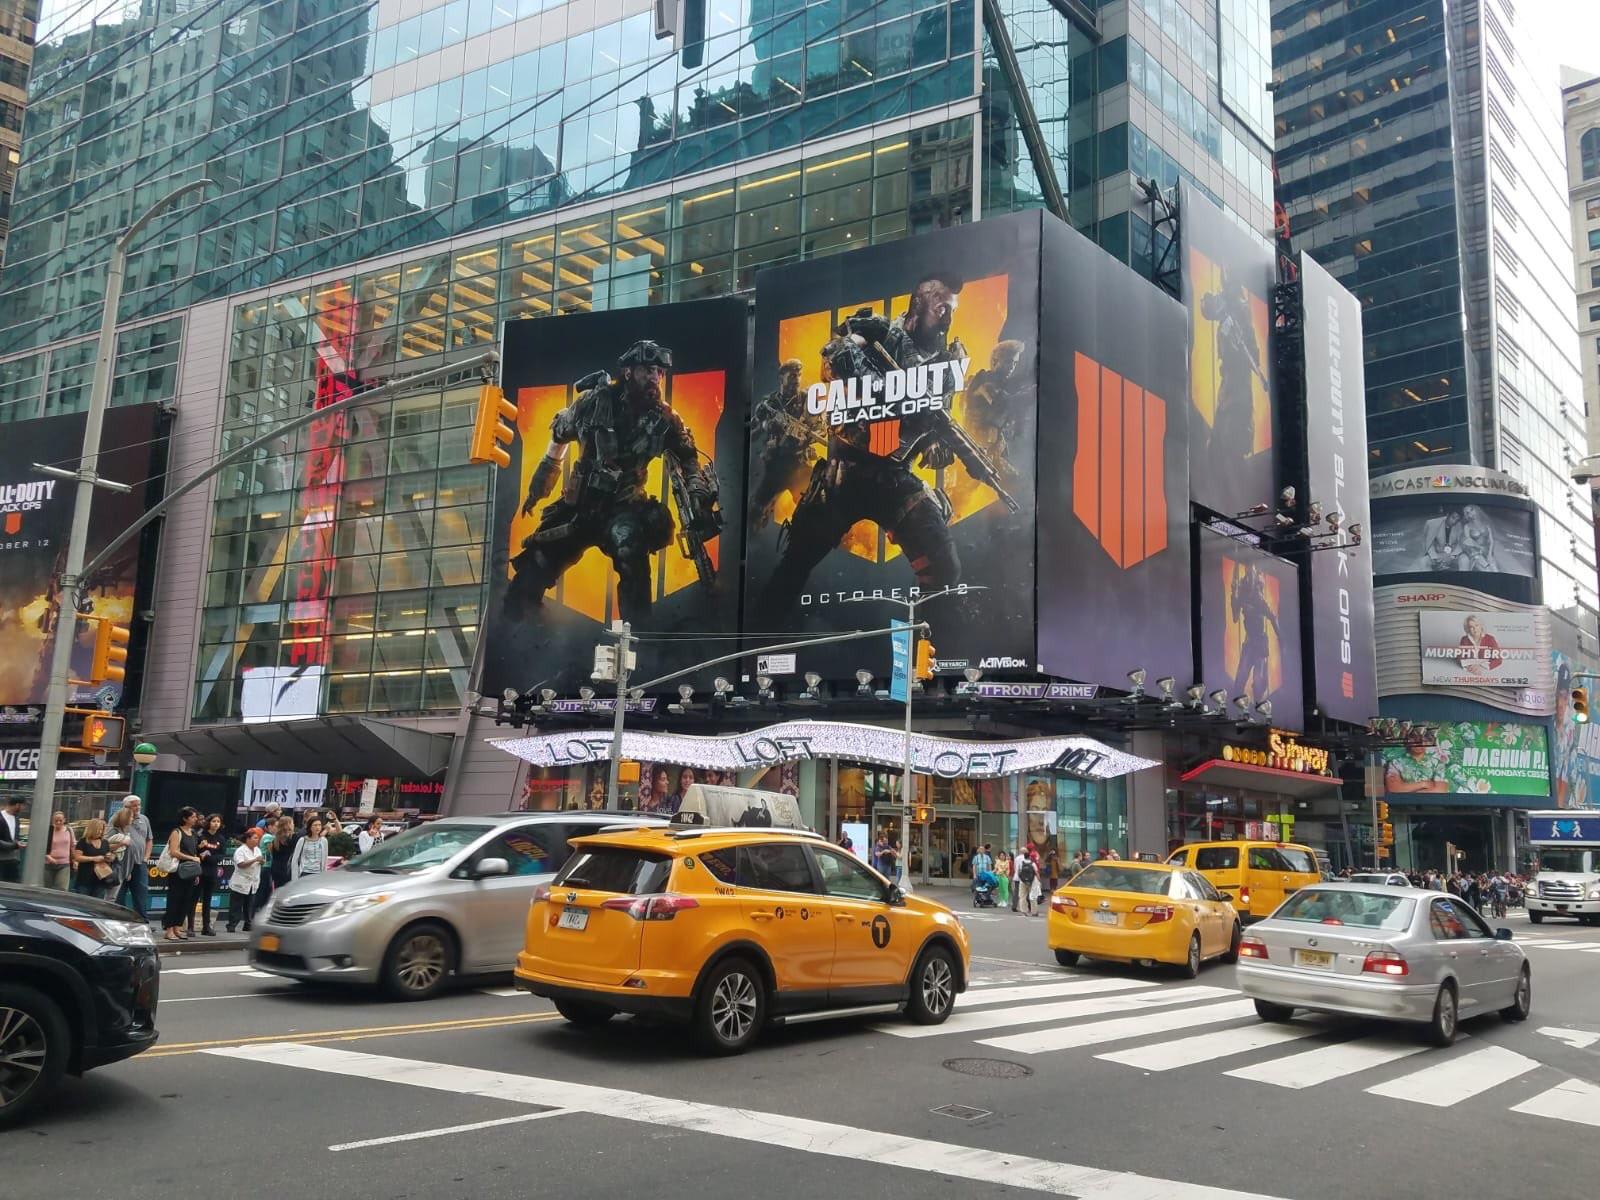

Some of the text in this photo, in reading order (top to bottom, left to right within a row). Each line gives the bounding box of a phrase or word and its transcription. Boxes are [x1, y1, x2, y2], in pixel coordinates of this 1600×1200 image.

[807, 375, 877, 416] CALL
[885, 357, 971, 404] DUTY
[830, 396, 943, 426] BLACK OPS
[16, 480, 56, 502] DUTY
[1370, 476, 1432, 494] OMCAST
[22, 501, 42, 511] OPS
[1330, 366, 1345, 446] DUTY
[1338, 588, 1351, 665] OPS
[38, 539, 49, 547] 12
[800, 583, 968, 605] OCTOBER 12
[1396, 593, 1446, 603] SHARP
[1424, 647, 1534, 660] MURPHY BROWN
[758, 660, 768, 670] M
[938, 656, 1027, 669] TREYARCH ACTIVISION
[1453, 676, 1500, 684] THURSDAYS
[1050, 686, 1093, 697] PRIME
[734, 736, 813, 763] LOFT
[911, 748, 1017, 778] LOFT
[1463, 747, 1531, 769] MAGNUM
[1462, 767, 1486, 776] NEW
[1487, 768, 1526, 777] MONDAYS
